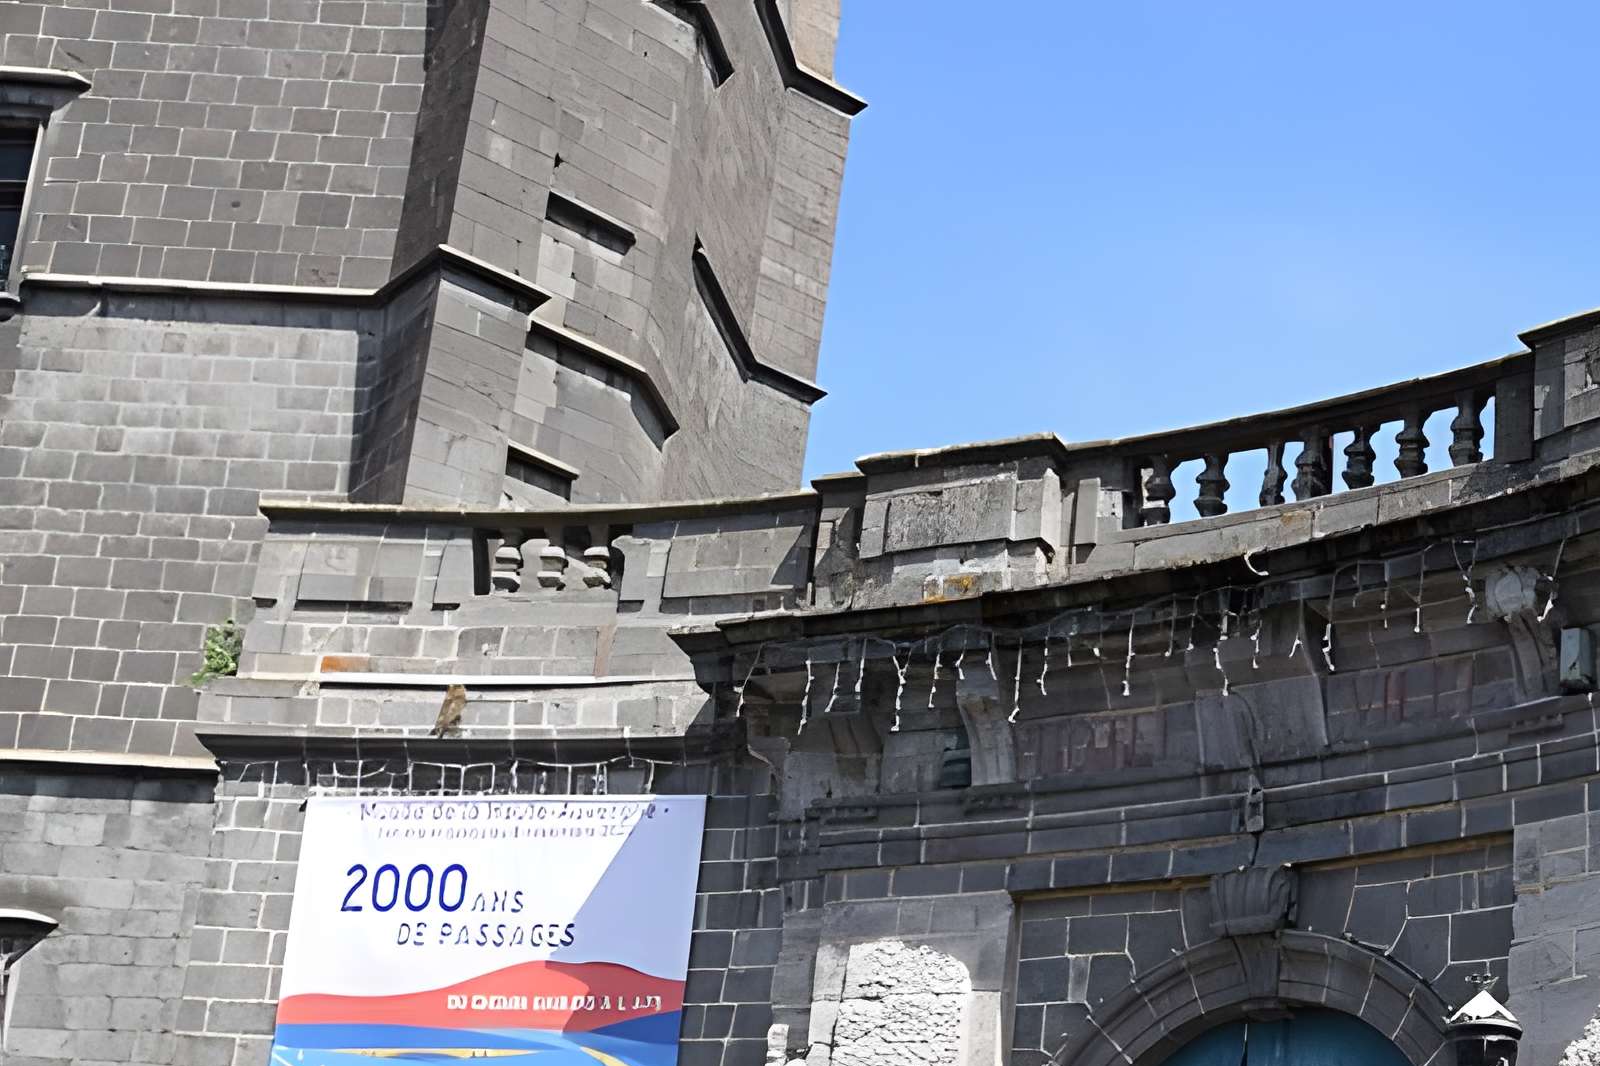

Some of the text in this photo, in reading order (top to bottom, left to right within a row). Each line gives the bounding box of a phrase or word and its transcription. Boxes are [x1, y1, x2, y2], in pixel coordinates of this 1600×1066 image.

[340, 863, 468, 912] 2000
[397, 922, 576, 947] DE PASSAGES
